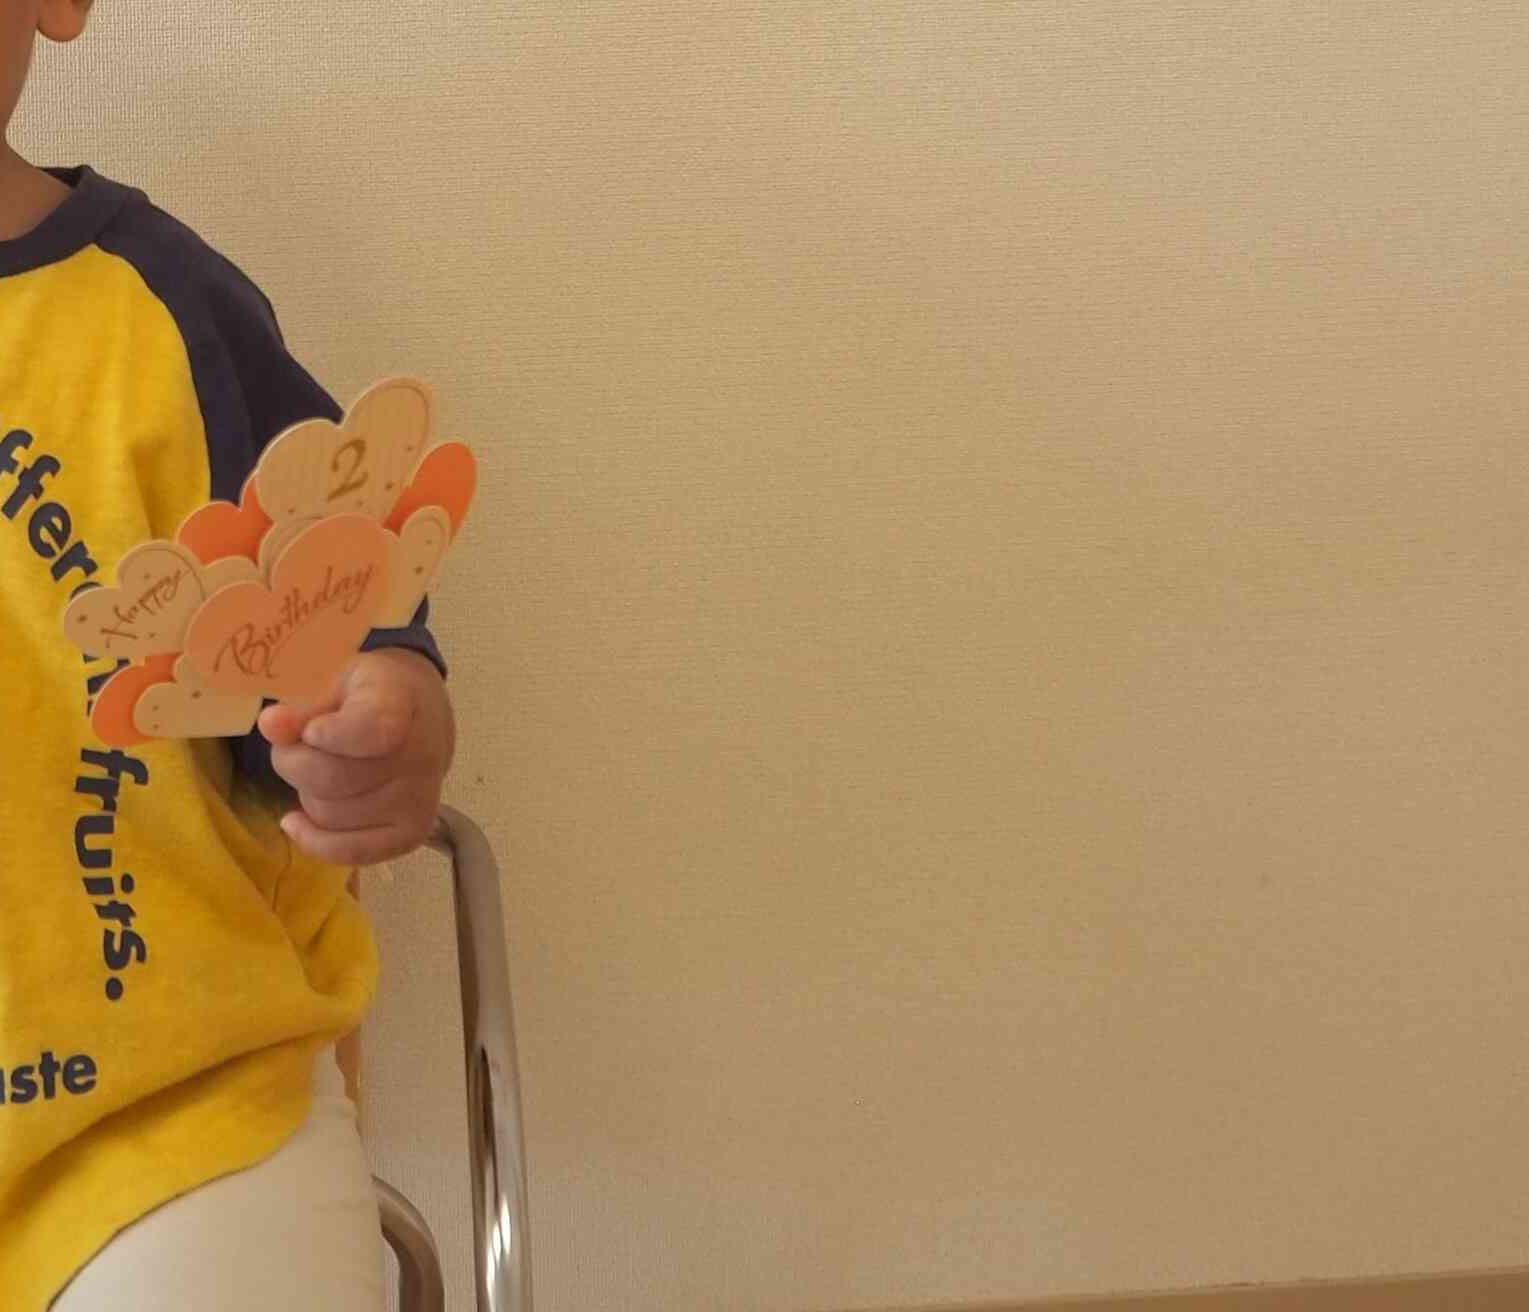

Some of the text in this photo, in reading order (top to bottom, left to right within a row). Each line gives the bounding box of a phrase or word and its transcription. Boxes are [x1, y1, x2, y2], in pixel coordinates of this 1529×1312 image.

[326, 439, 369, 501] 2
[213, 563, 374, 679] Birthday
[73, 747, 150, 1001] fruits.
